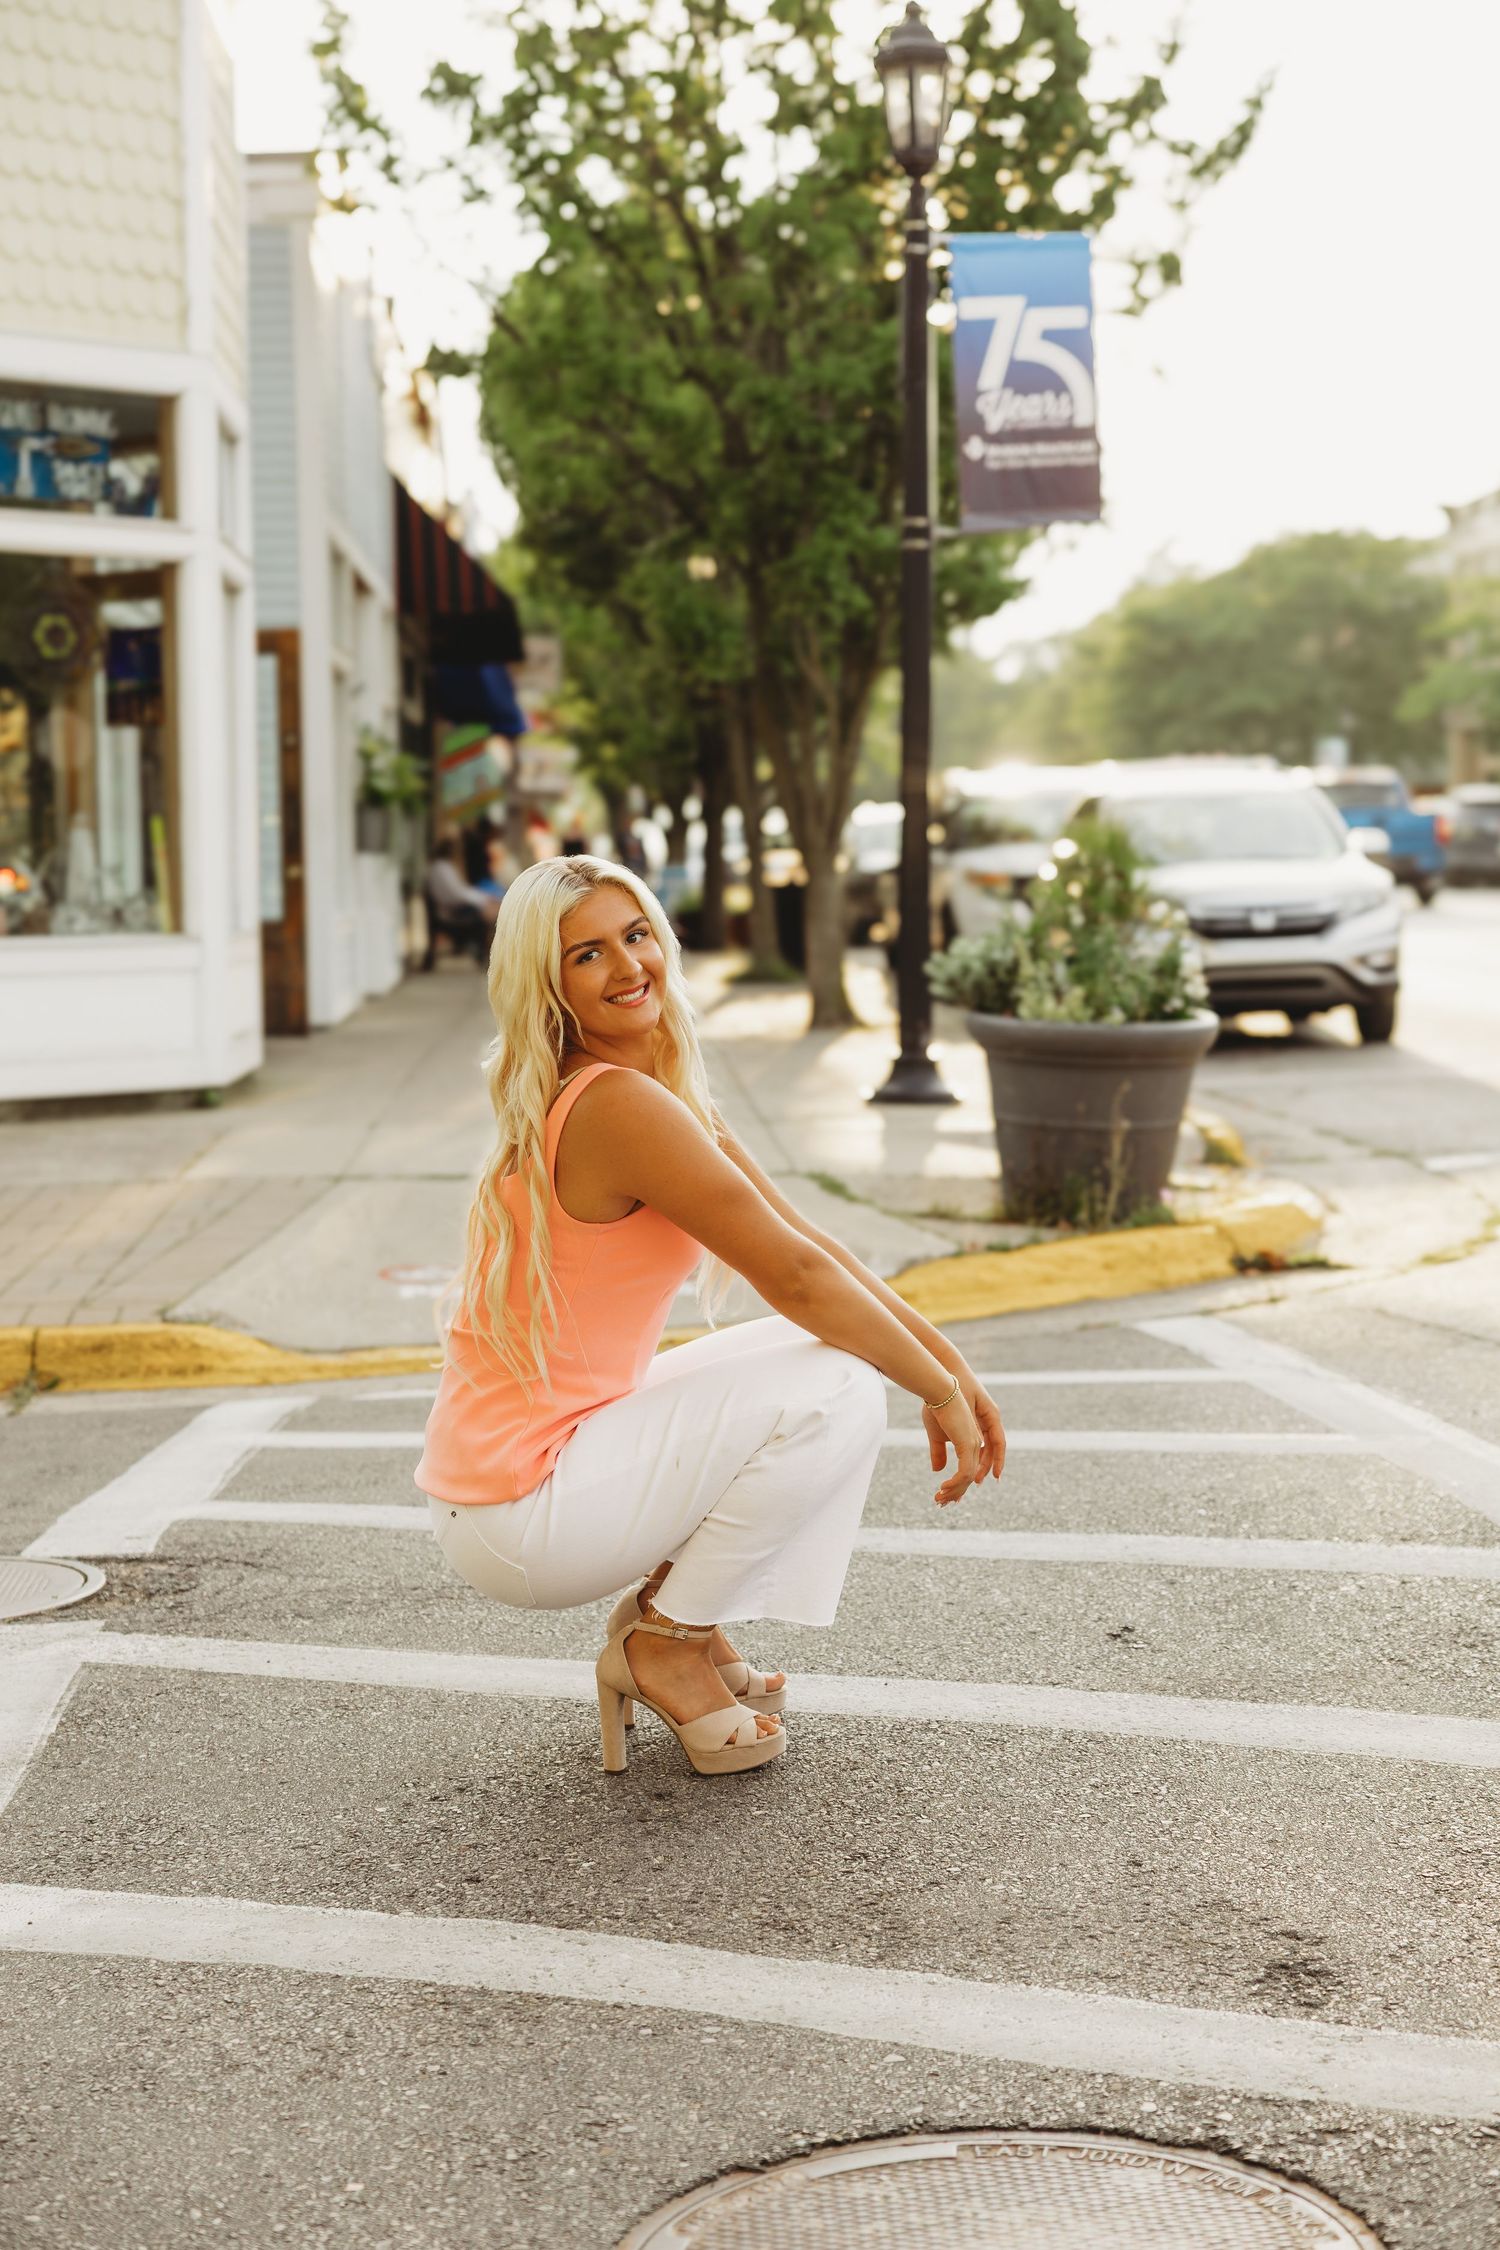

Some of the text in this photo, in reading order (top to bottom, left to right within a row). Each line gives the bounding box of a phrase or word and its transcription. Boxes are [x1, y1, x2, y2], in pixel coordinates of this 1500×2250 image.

[958, 295, 1095, 428] 75
[974, 2145, 1056, 2159] EAST
[1068, 2148, 1188, 2175] JORDAN
[1199, 2170, 1261, 2198] IRON
